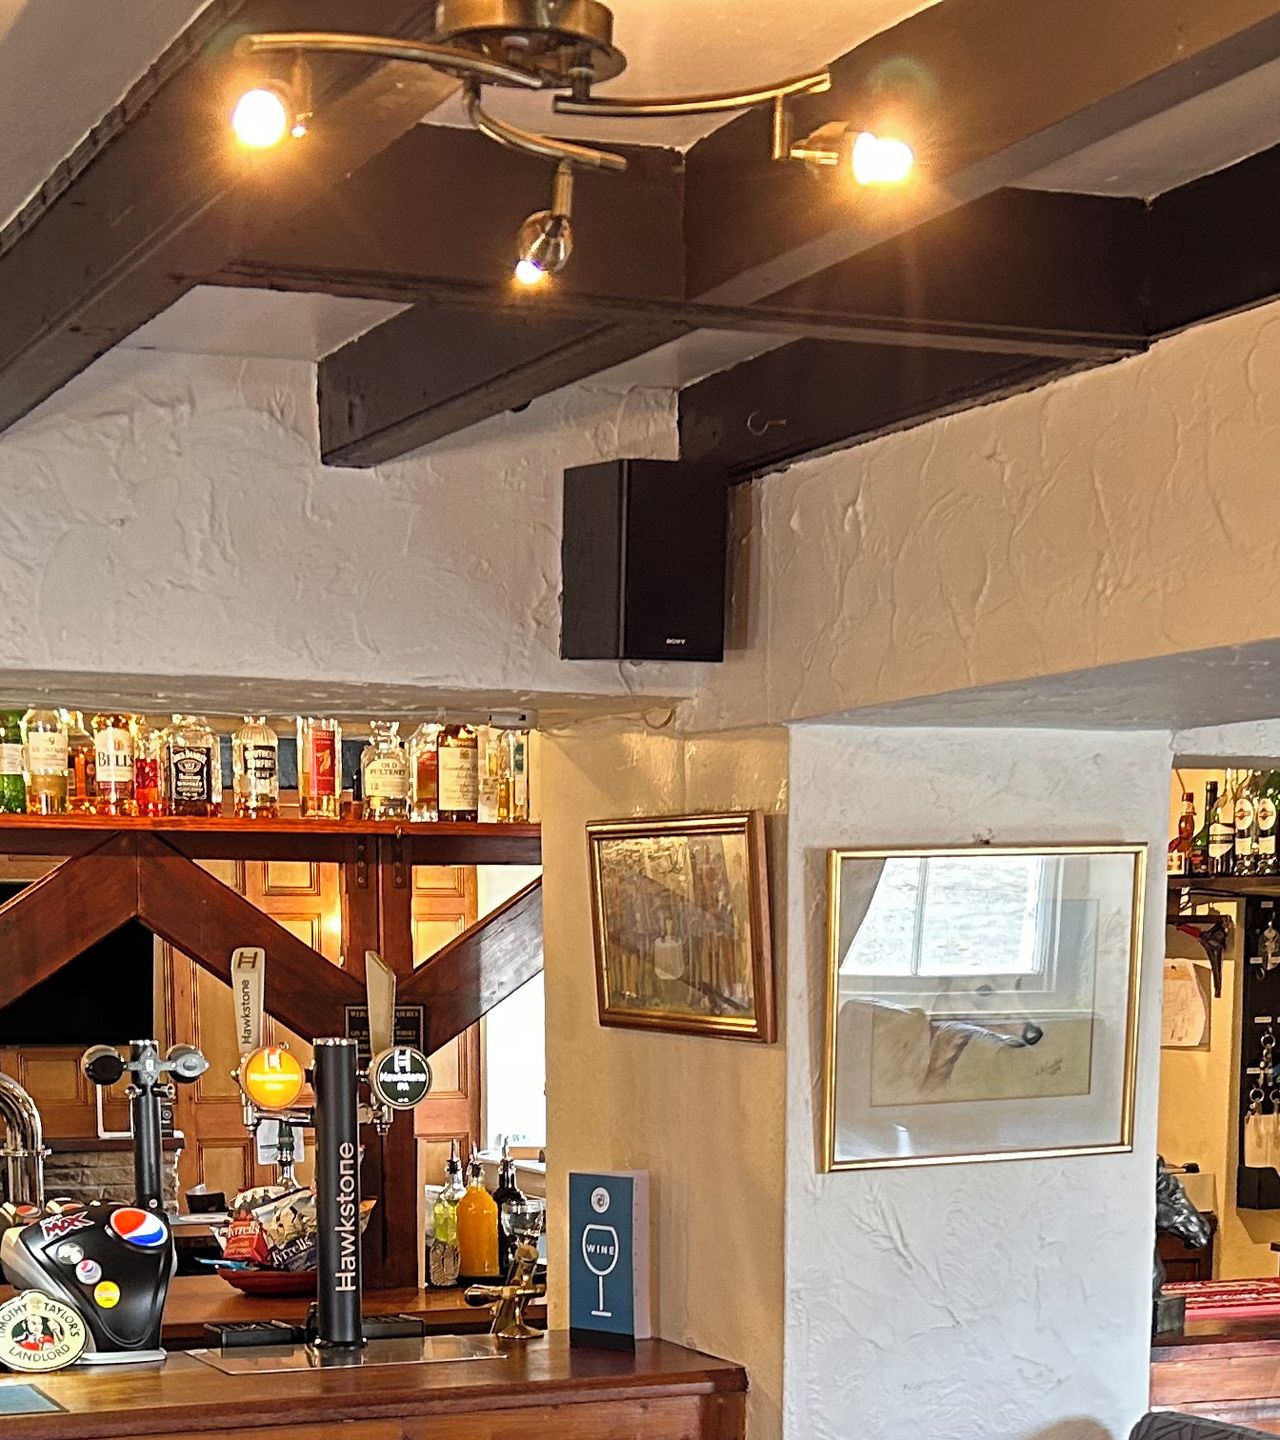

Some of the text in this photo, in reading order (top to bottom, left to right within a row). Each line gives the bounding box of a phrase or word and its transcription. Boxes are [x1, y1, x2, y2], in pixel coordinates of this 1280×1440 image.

[241, 979, 252, 1045] Hawkstone
[334, 1141, 358, 1293] Hawkstone
[586, 1243, 615, 1256] WINE
[43, 1302, 81, 1338] TAYLOR'S
[8, 1343, 71, 1363] LANDLORD
